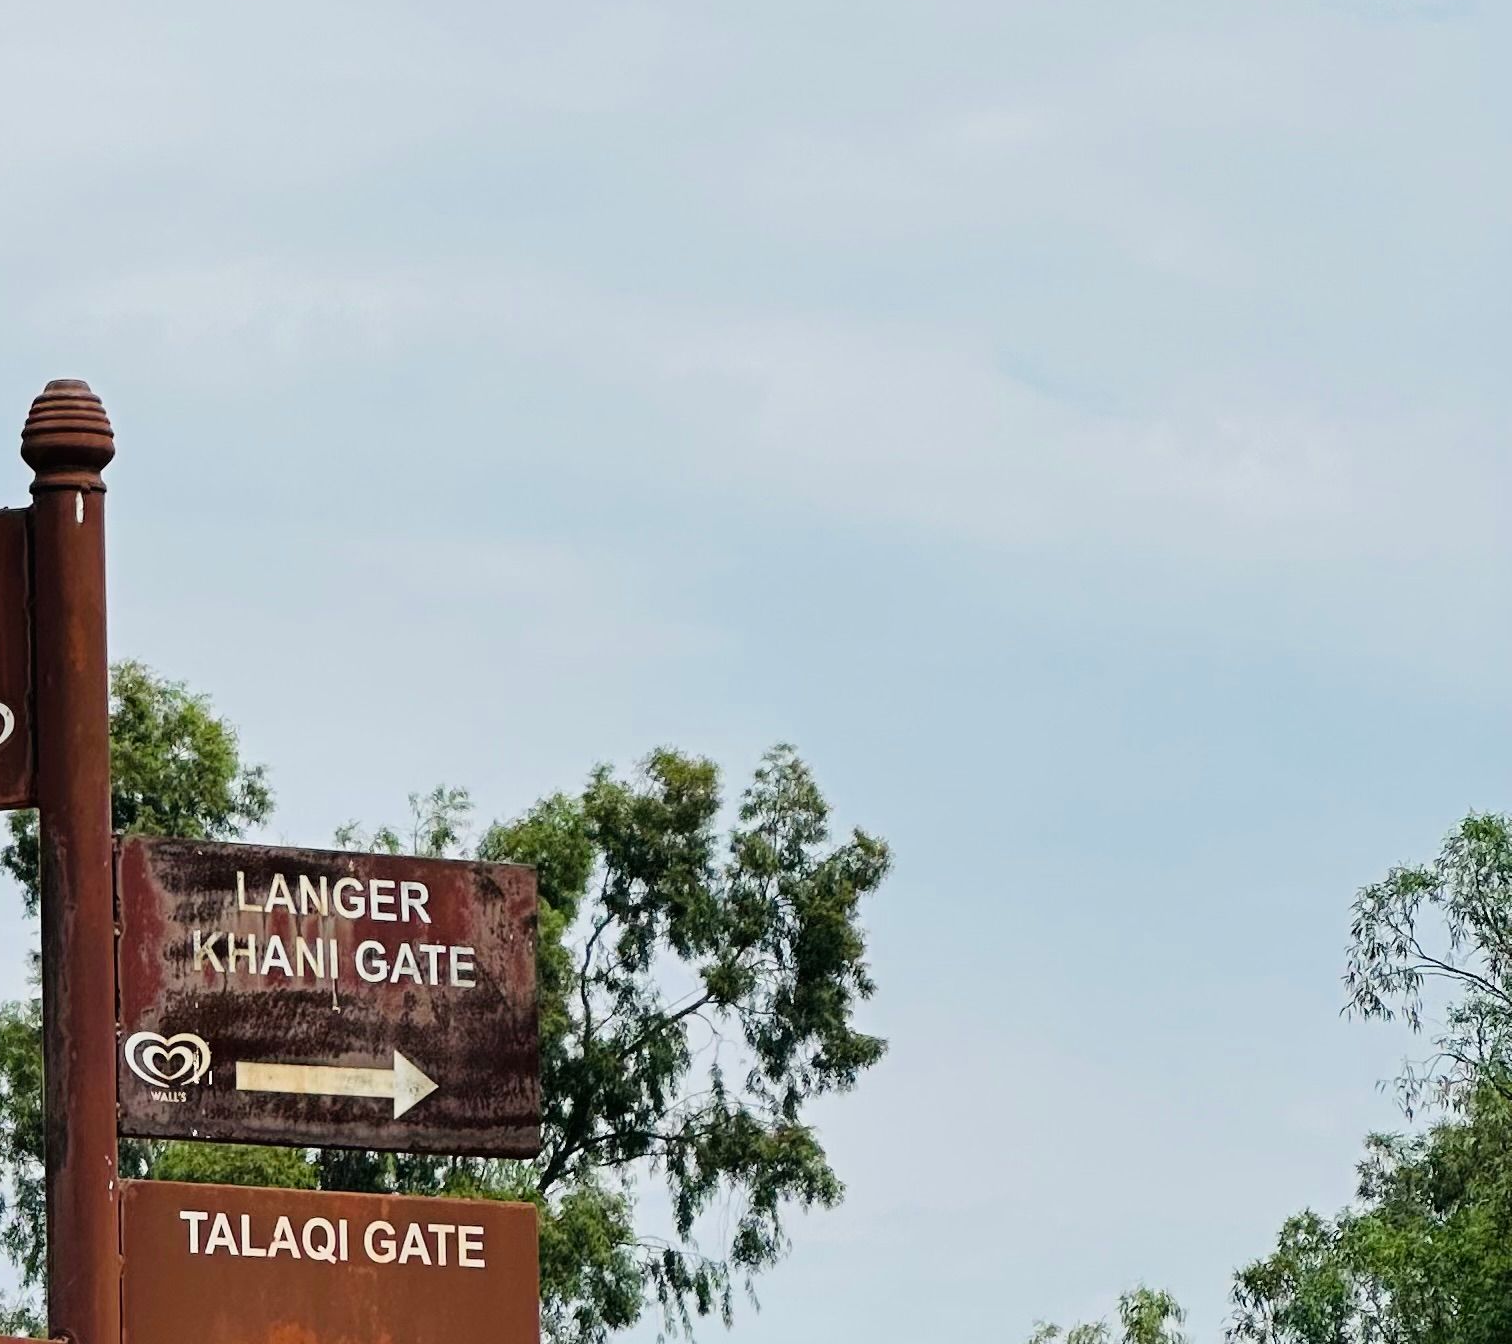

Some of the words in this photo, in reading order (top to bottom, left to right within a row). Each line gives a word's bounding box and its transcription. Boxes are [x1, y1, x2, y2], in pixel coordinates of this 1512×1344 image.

[236, 871, 432, 924] LANGER
[192, 930, 338, 979] KHANI
[355, 939, 477, 988] GATE
[150, 1090, 187, 1103] WALL'S
[179, 1210, 348, 1264] TALAQI
[363, 1220, 486, 1268] GATE
